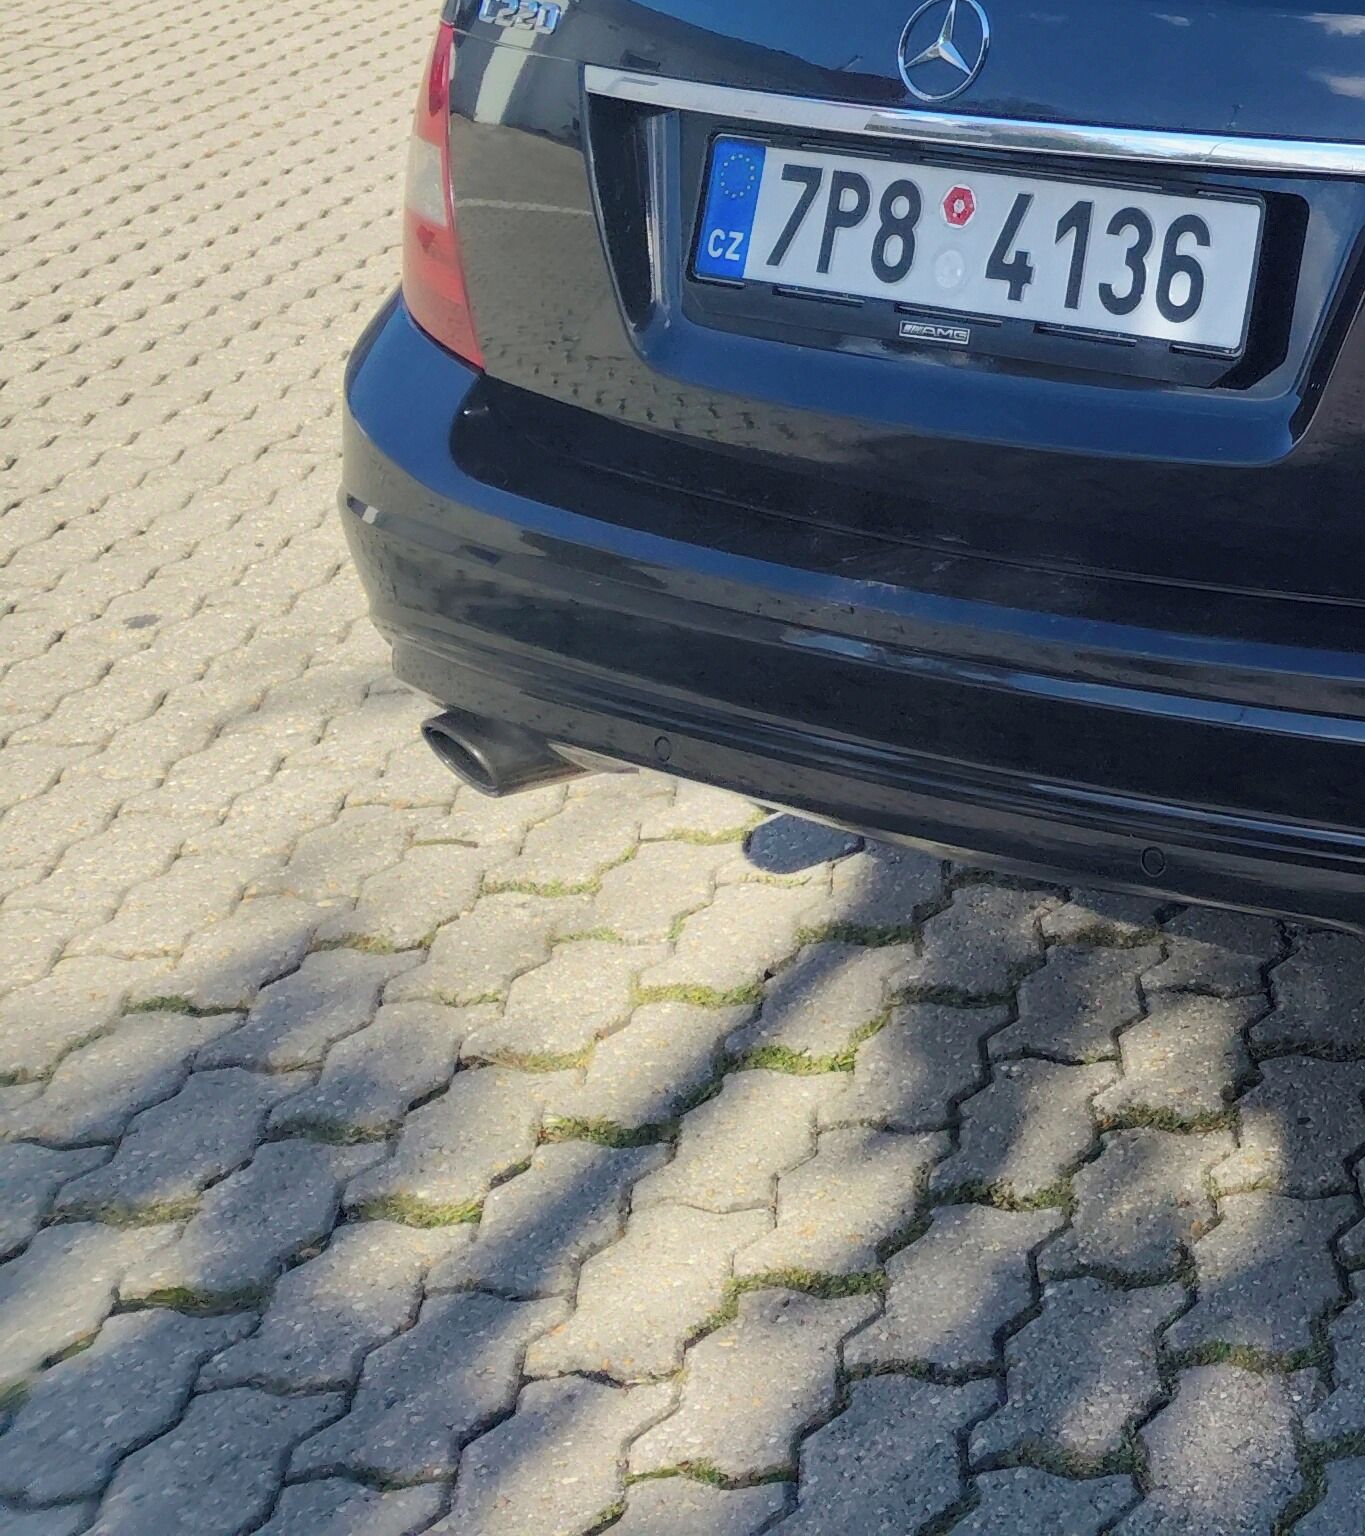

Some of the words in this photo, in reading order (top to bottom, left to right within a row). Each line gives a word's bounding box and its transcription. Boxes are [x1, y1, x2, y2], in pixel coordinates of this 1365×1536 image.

[707, 227, 744, 262] CZ
[765, 164, 923, 285] 7P8
[985, 193, 1213, 323] 4136
